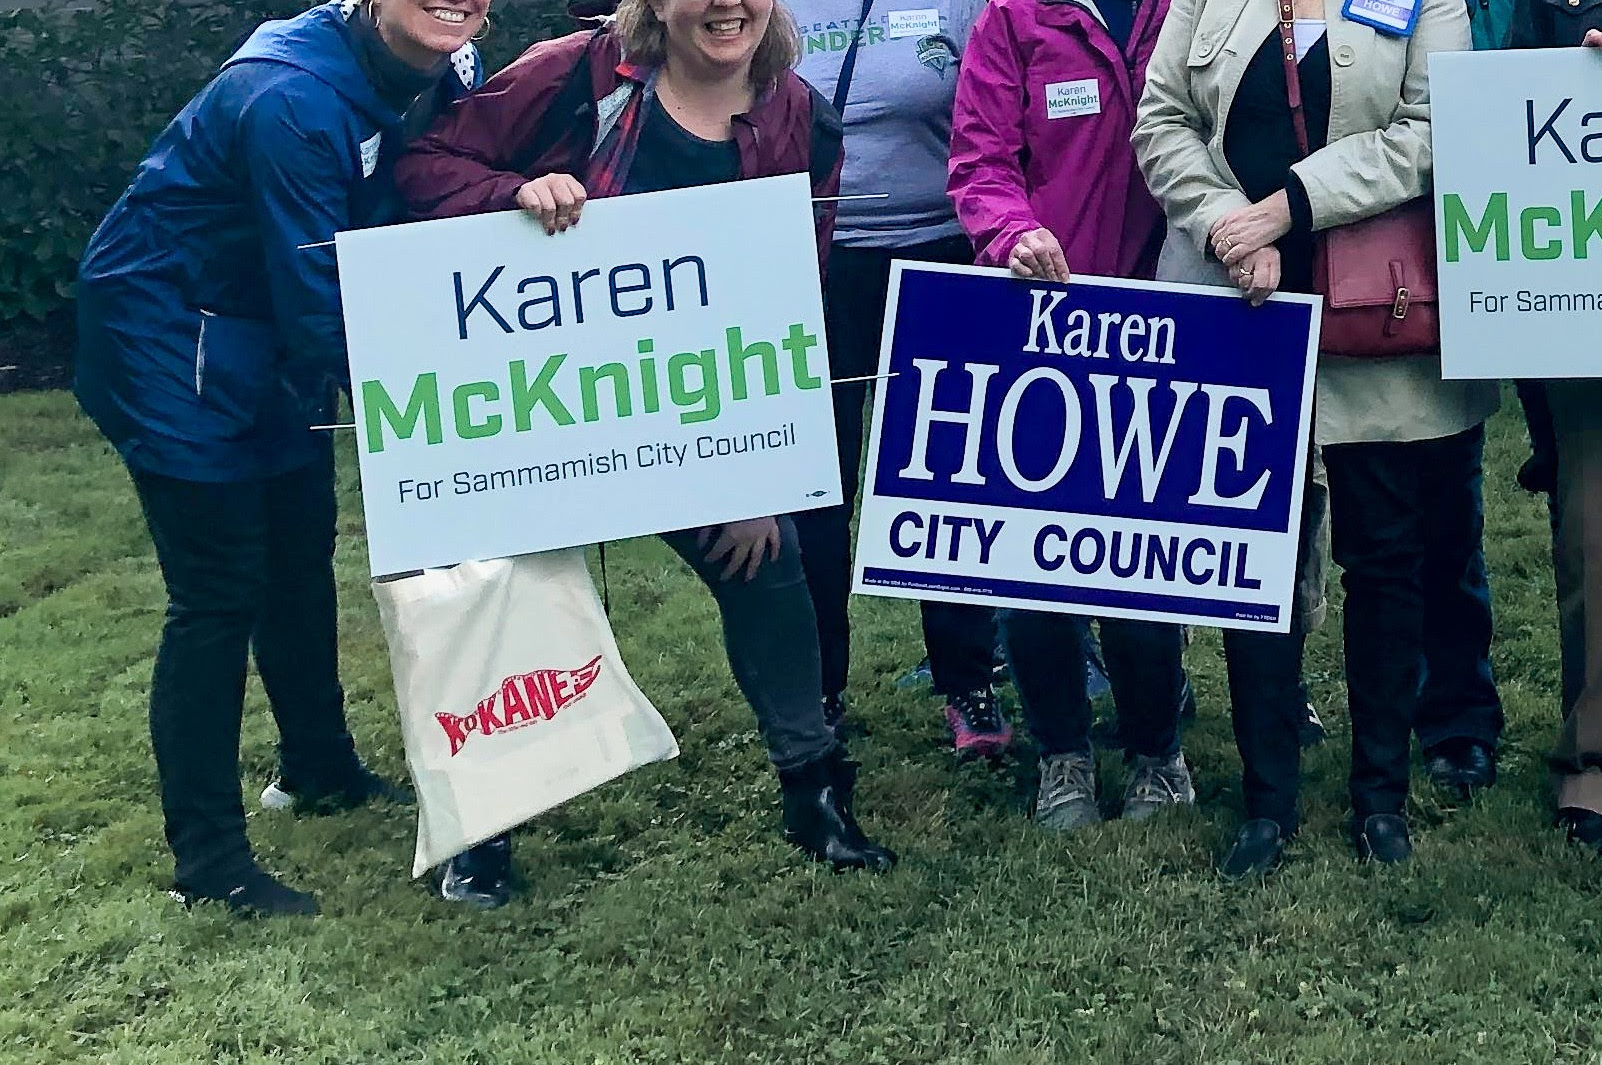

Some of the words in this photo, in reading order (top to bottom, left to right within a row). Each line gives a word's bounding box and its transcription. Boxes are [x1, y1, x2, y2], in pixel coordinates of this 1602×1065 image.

[890, 20, 938, 30] McKnight
[1048, 95, 1099, 109] McKnight
[453, 253, 709, 340] Karen
[1023, 289, 1176, 365] Karen
[1470, 291, 1508, 313] For
[361, 321, 822, 455] McKnight
[399, 479, 444, 503] For
[453, 449, 628, 495] Sammamish
[637, 443, 687, 468] City
[696, 422, 796, 459] Council
[898, 357, 1274, 511] HOWE
[888, 510, 1006, 565] CITY
[1033, 523, 1262, 590] COUNCIL
